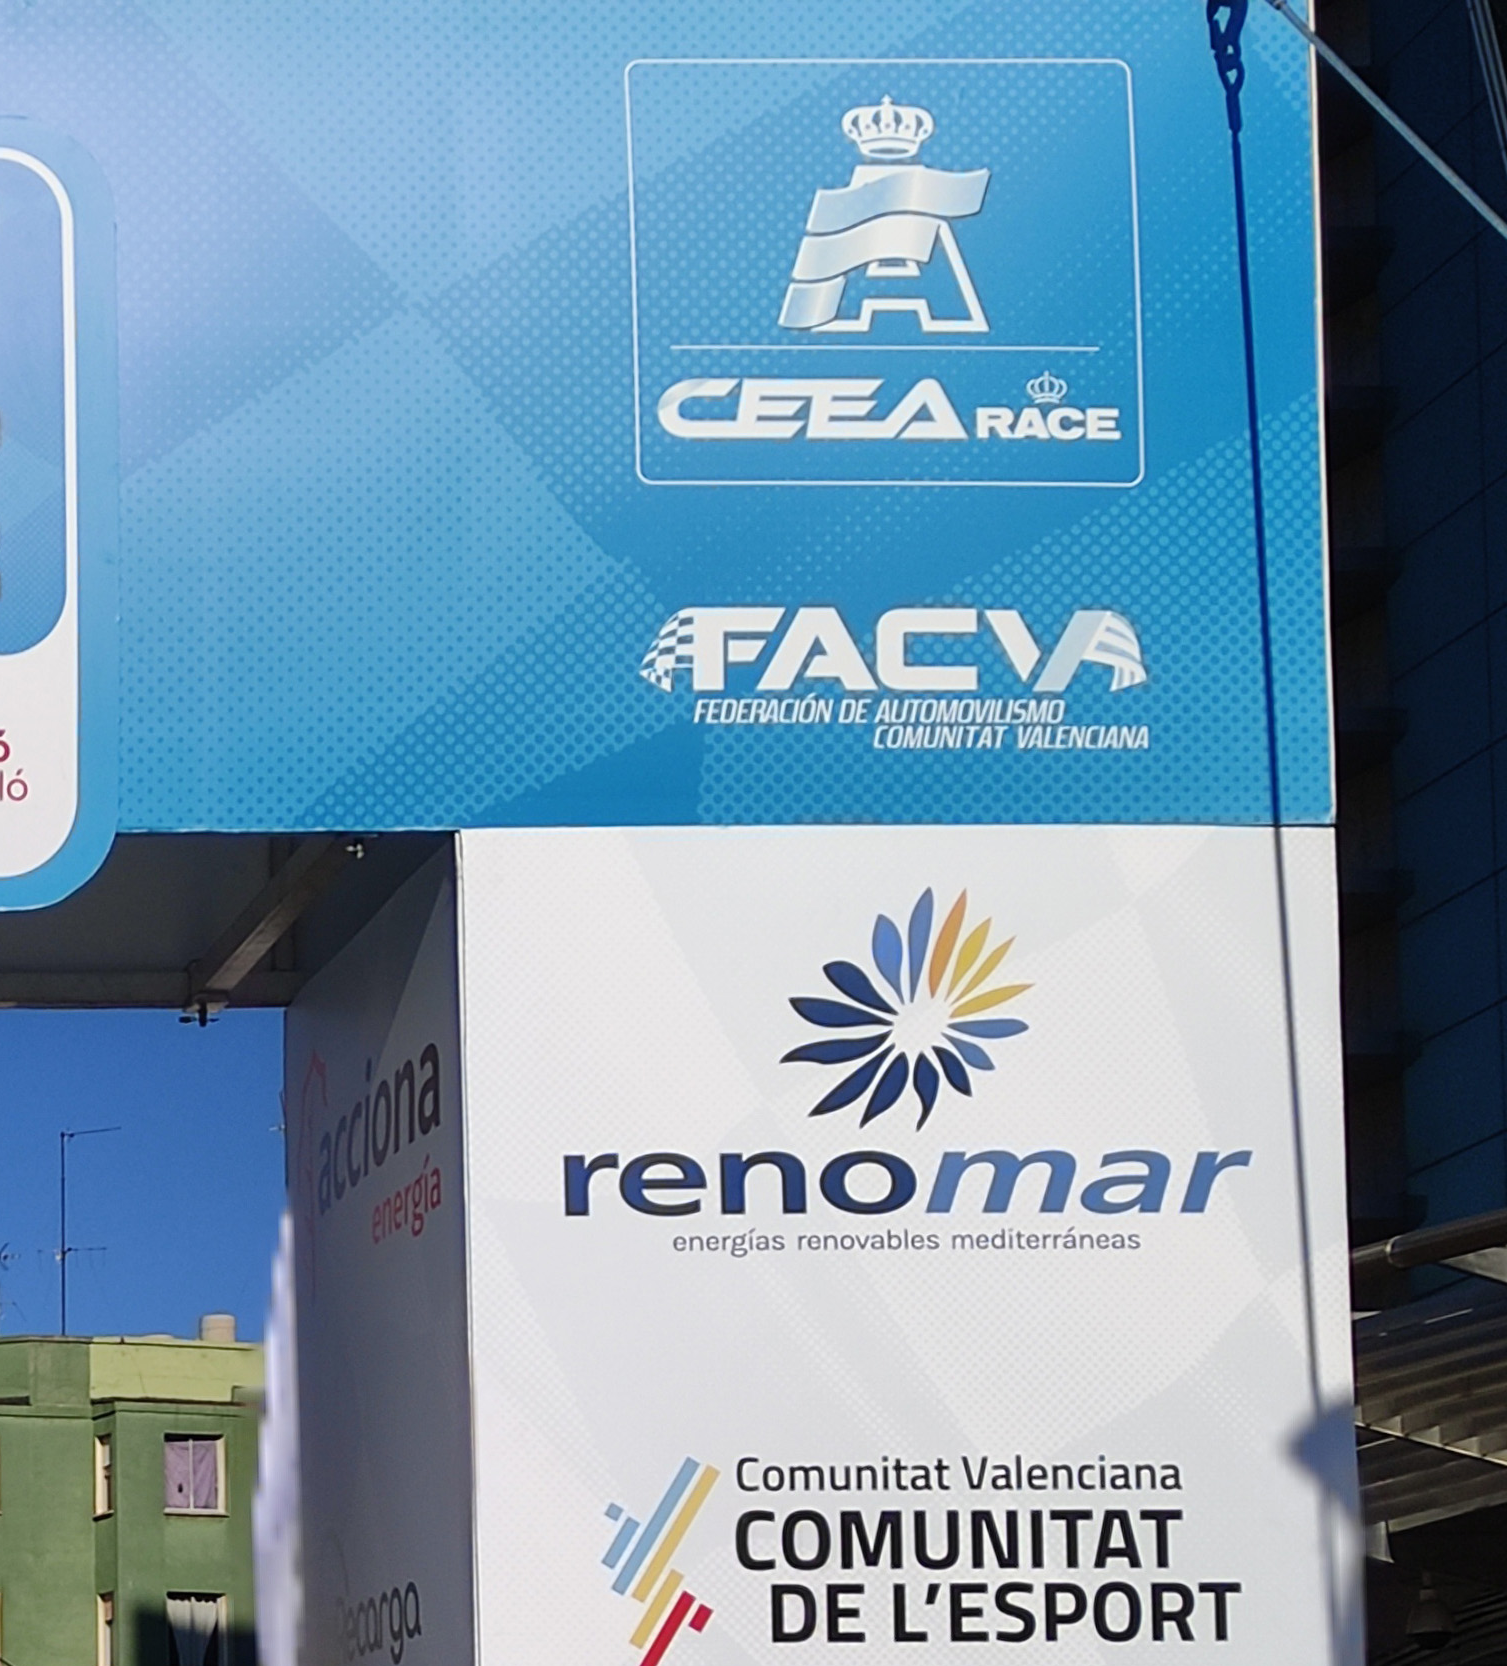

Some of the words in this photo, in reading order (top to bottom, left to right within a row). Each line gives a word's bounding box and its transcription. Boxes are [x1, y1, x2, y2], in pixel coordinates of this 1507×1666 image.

[976, 408, 1122, 441] RACE
[693, 694, 832, 724] FEDERACIÓN
[838, 698, 871, 724] DE
[875, 698, 1066, 724] AUTOMOVILISMO
[873, 724, 1008, 749] COMUNITAT
[1016, 726, 1150, 749] VALENCIANA
[318, 1042, 440, 1216] acciona
[372, 1153, 441, 1244] energía
[562, 1148, 1253, 1217] renomar
[672, 1229, 786, 1258] energías
[796, 1227, 940, 1252] renovables
[950, 1226, 1141, 1251] mediterráneas
[735, 1456, 951, 1492] Comunitat
[961, 1455, 1182, 1490] Valenciana
[735, 1508, 1184, 1571] COMUNITAT
[770, 1582, 866, 1643] DE
[893, 1580, 1242, 1643] L'ESPORT
